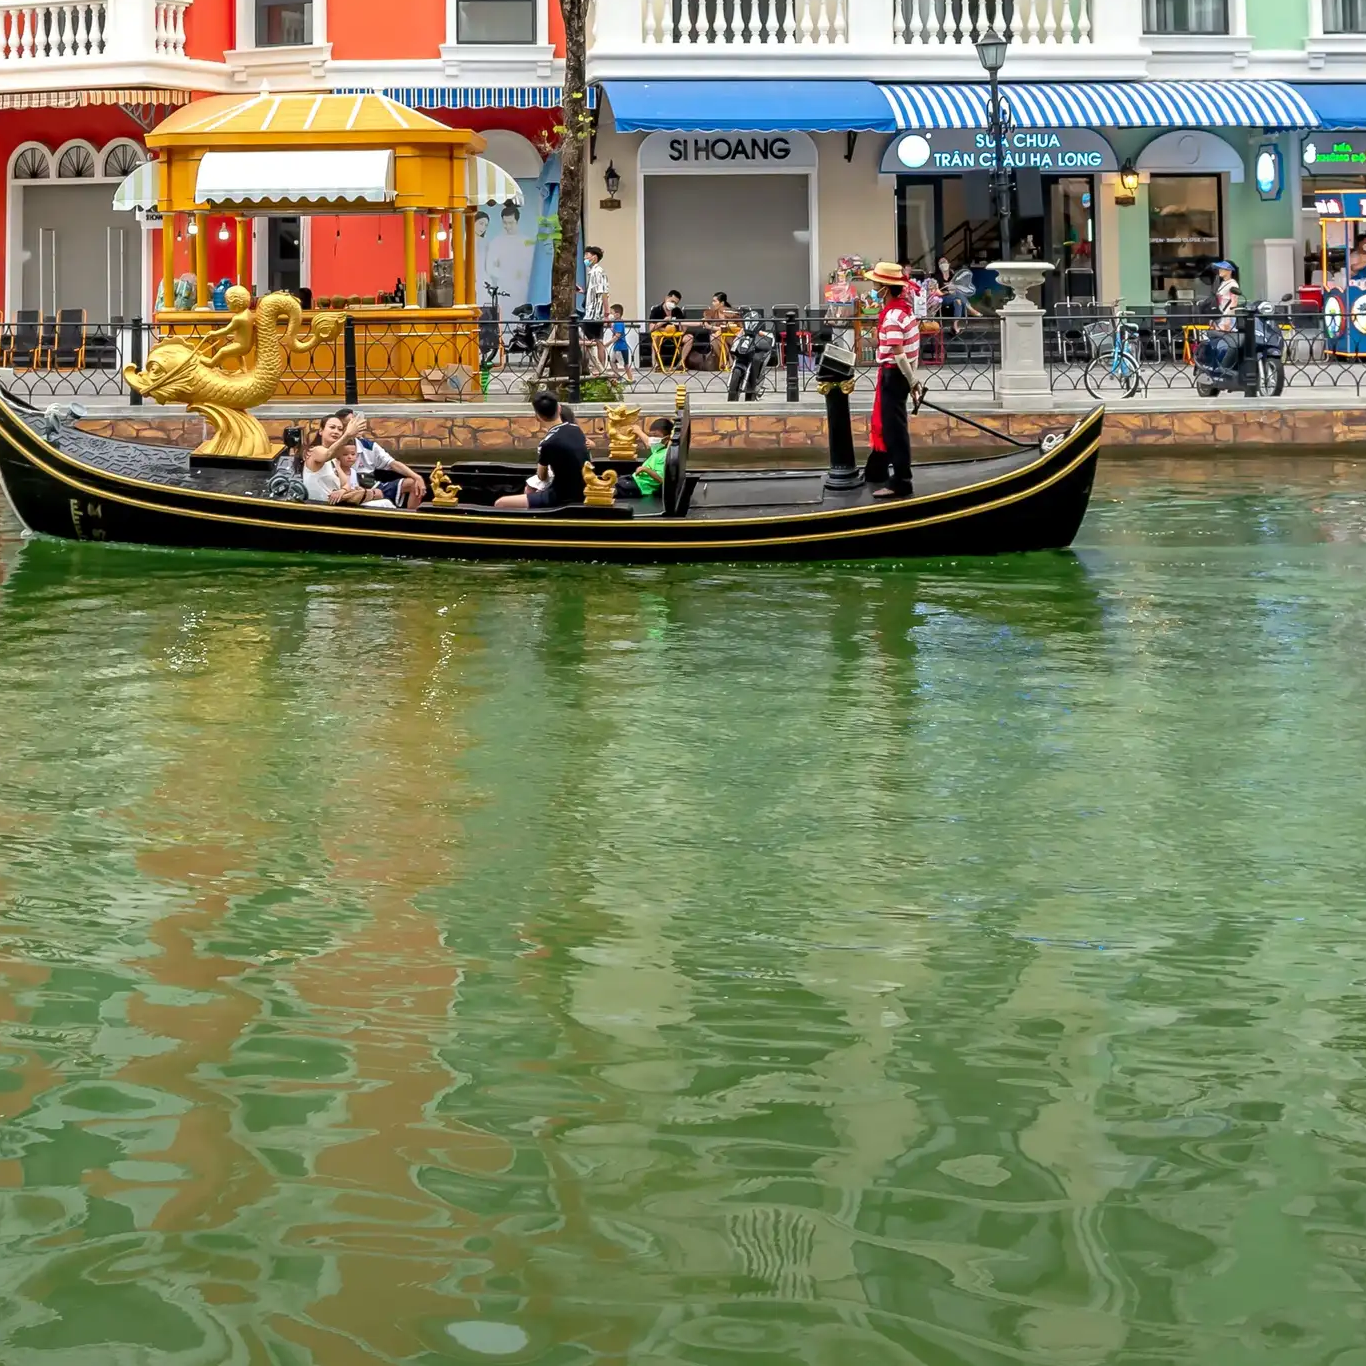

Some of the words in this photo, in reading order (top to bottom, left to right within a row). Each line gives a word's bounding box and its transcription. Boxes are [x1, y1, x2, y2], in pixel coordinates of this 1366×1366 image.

[668, 138, 688, 161] SI
[694, 137, 792, 161] HOANG
[1013, 133, 1060, 148] CHUA
[933, 150, 975, 167] TRÂN
[1030, 152, 1052, 169] HẠ
[1058, 152, 1102, 167] LONG
